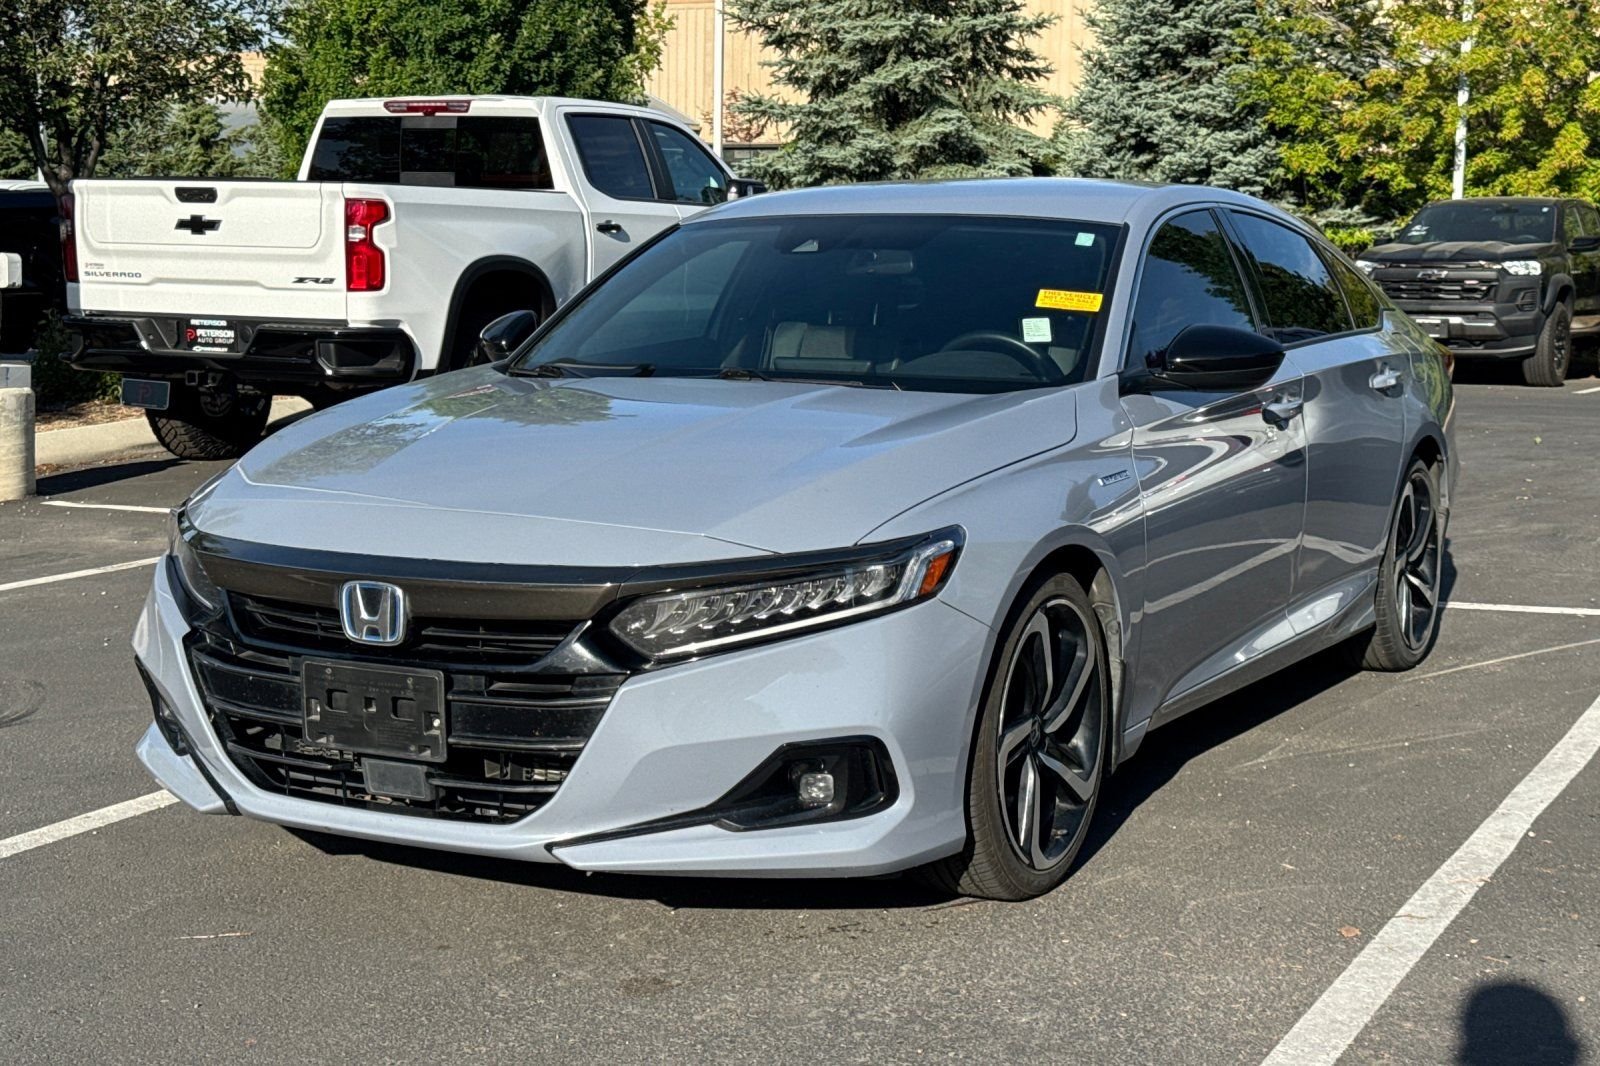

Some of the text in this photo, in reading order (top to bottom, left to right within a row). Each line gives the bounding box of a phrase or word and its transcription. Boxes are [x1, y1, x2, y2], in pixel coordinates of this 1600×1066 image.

[291, 276, 337, 285] ZR2
[1063, 292, 1097, 300] VEHICLE
[196, 328, 235, 338] PETERSON
[214, 337, 235, 345] GROUP
